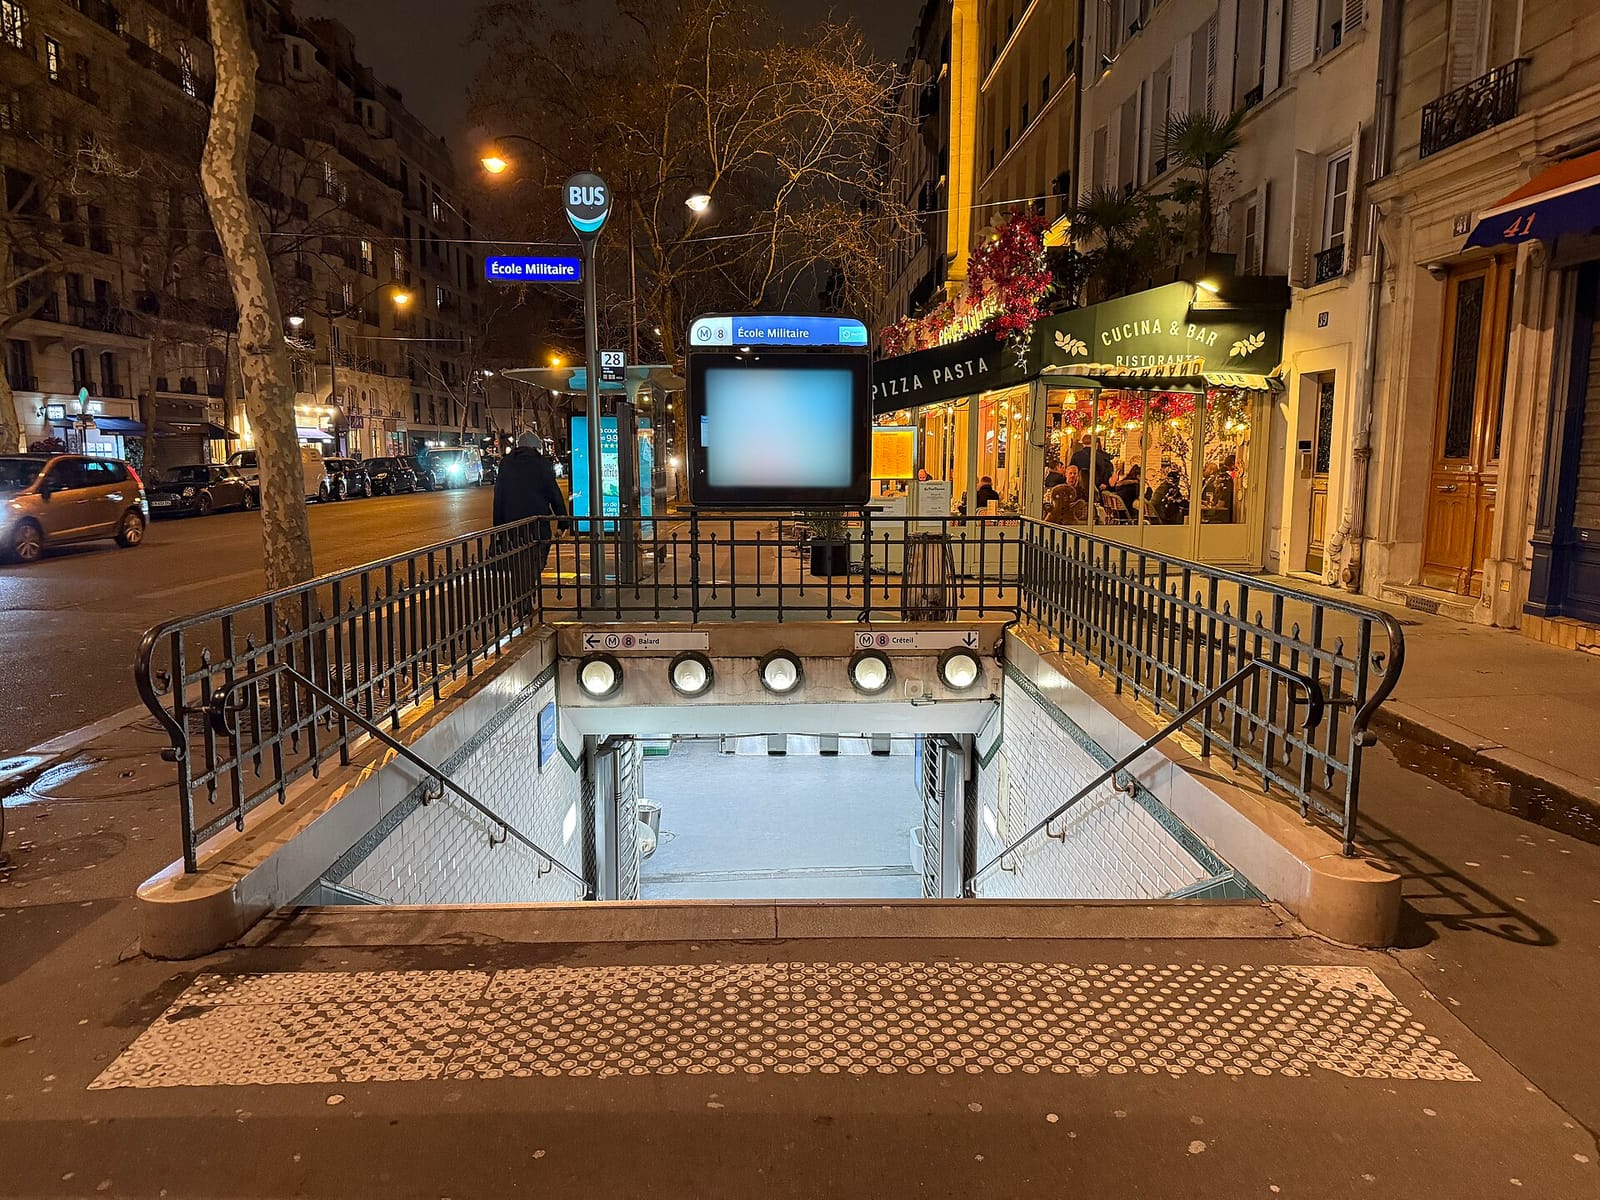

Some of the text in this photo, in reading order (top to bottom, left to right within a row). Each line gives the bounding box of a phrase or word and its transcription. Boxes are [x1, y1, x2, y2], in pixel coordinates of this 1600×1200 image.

[569, 186, 605, 206] BUS
[1456, 216, 1468, 233] 41
[1503, 212, 1536, 238] 41
[491, 261, 575, 275] École Militaire
[737, 326, 765, 338] École
[767, 327, 809, 338] Militaire
[1101, 319, 1219, 347] CUCINA & BAR
[604, 353, 621, 366] 28
[871, 357, 989, 400] PIZZA PASTA
[891, 636, 914, 644] Créteil
